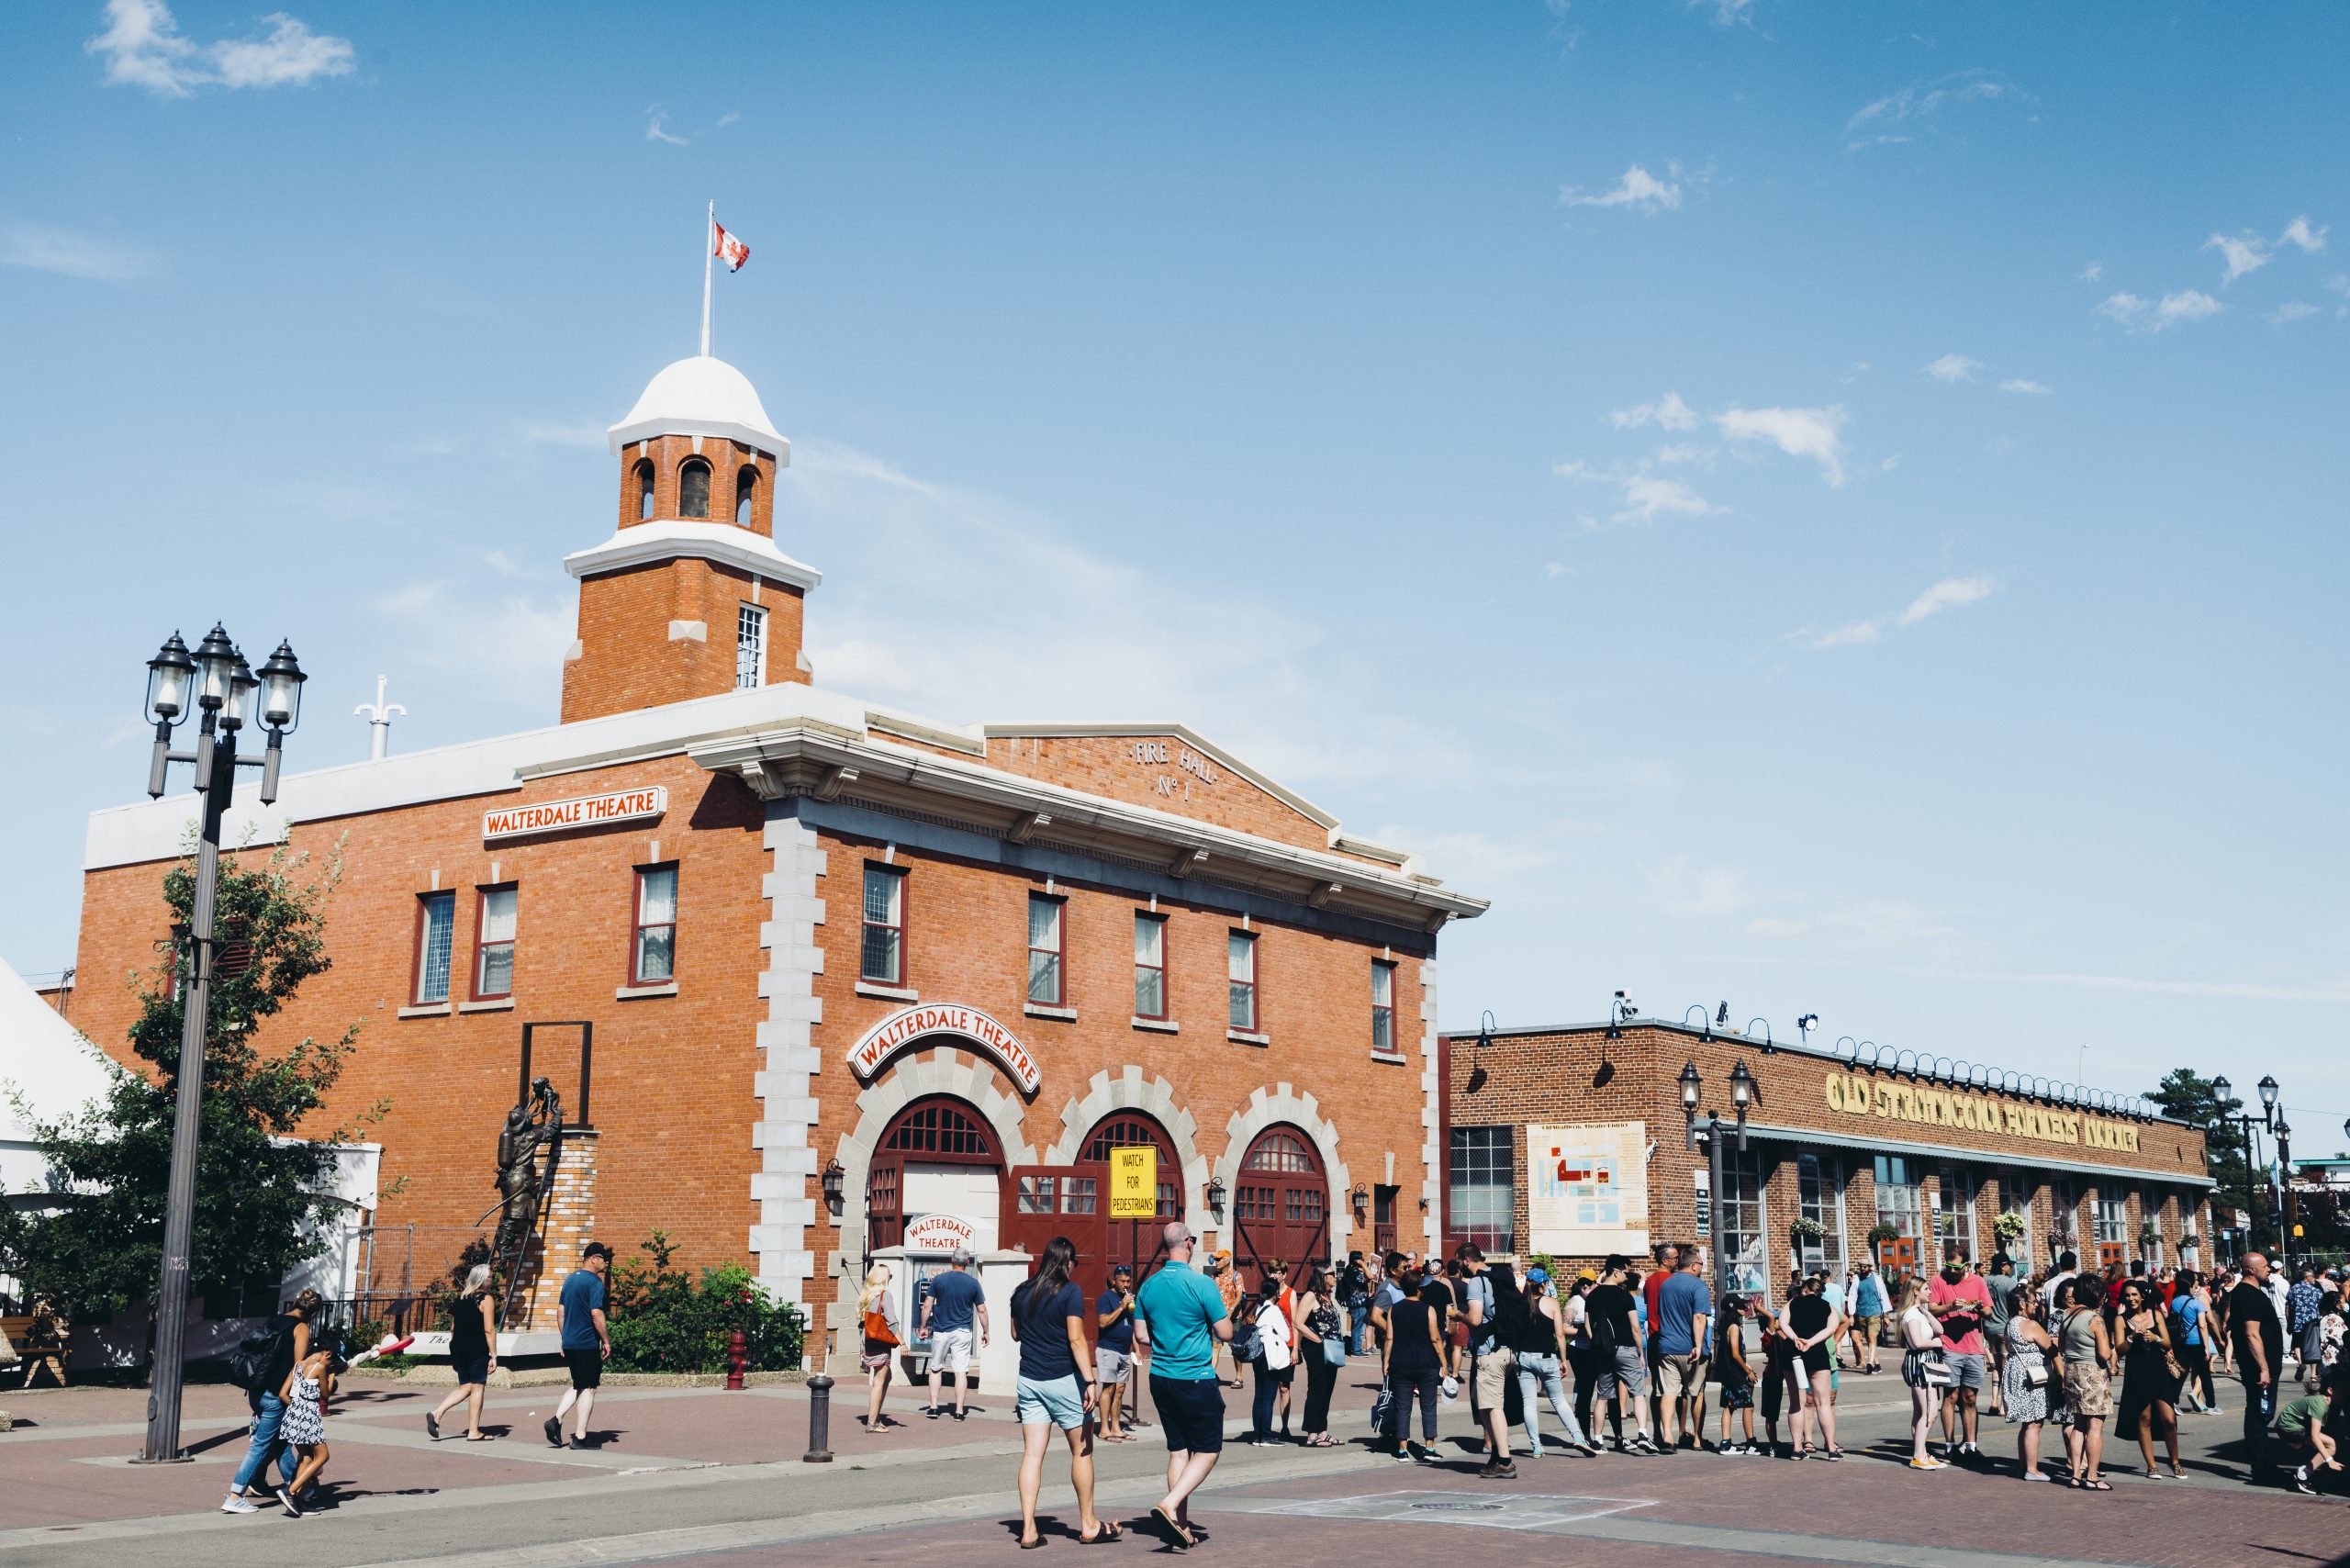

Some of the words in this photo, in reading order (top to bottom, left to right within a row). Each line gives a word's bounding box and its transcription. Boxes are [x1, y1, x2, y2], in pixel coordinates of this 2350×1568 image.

[1136, 742, 1169, 765] FIRE
[1180, 748, 1212, 785] HALL
[1184, 782, 1190, 802] 1
[487, 803, 582, 834] WALTERDALE
[586, 791, 655, 820] THEATRE
[860, 1009, 968, 1067] WALTERDALE
[974, 1015, 1036, 1084] THEATRE
[1826, 1072, 1870, 1114] OLD
[1874, 1081, 2002, 1134] STRATHCONA
[2085, 1116, 2139, 1154] MARKET
[1122, 1154, 1144, 1167] WATCH
[1126, 1176, 1139, 1189] FOR
[1113, 1197, 1154, 1211] PEDESTRIANS
[909, 1218, 972, 1240] WALTERDALE
[919, 1238, 961, 1249] THEATRE
[429, 1335, 449, 1344] The
